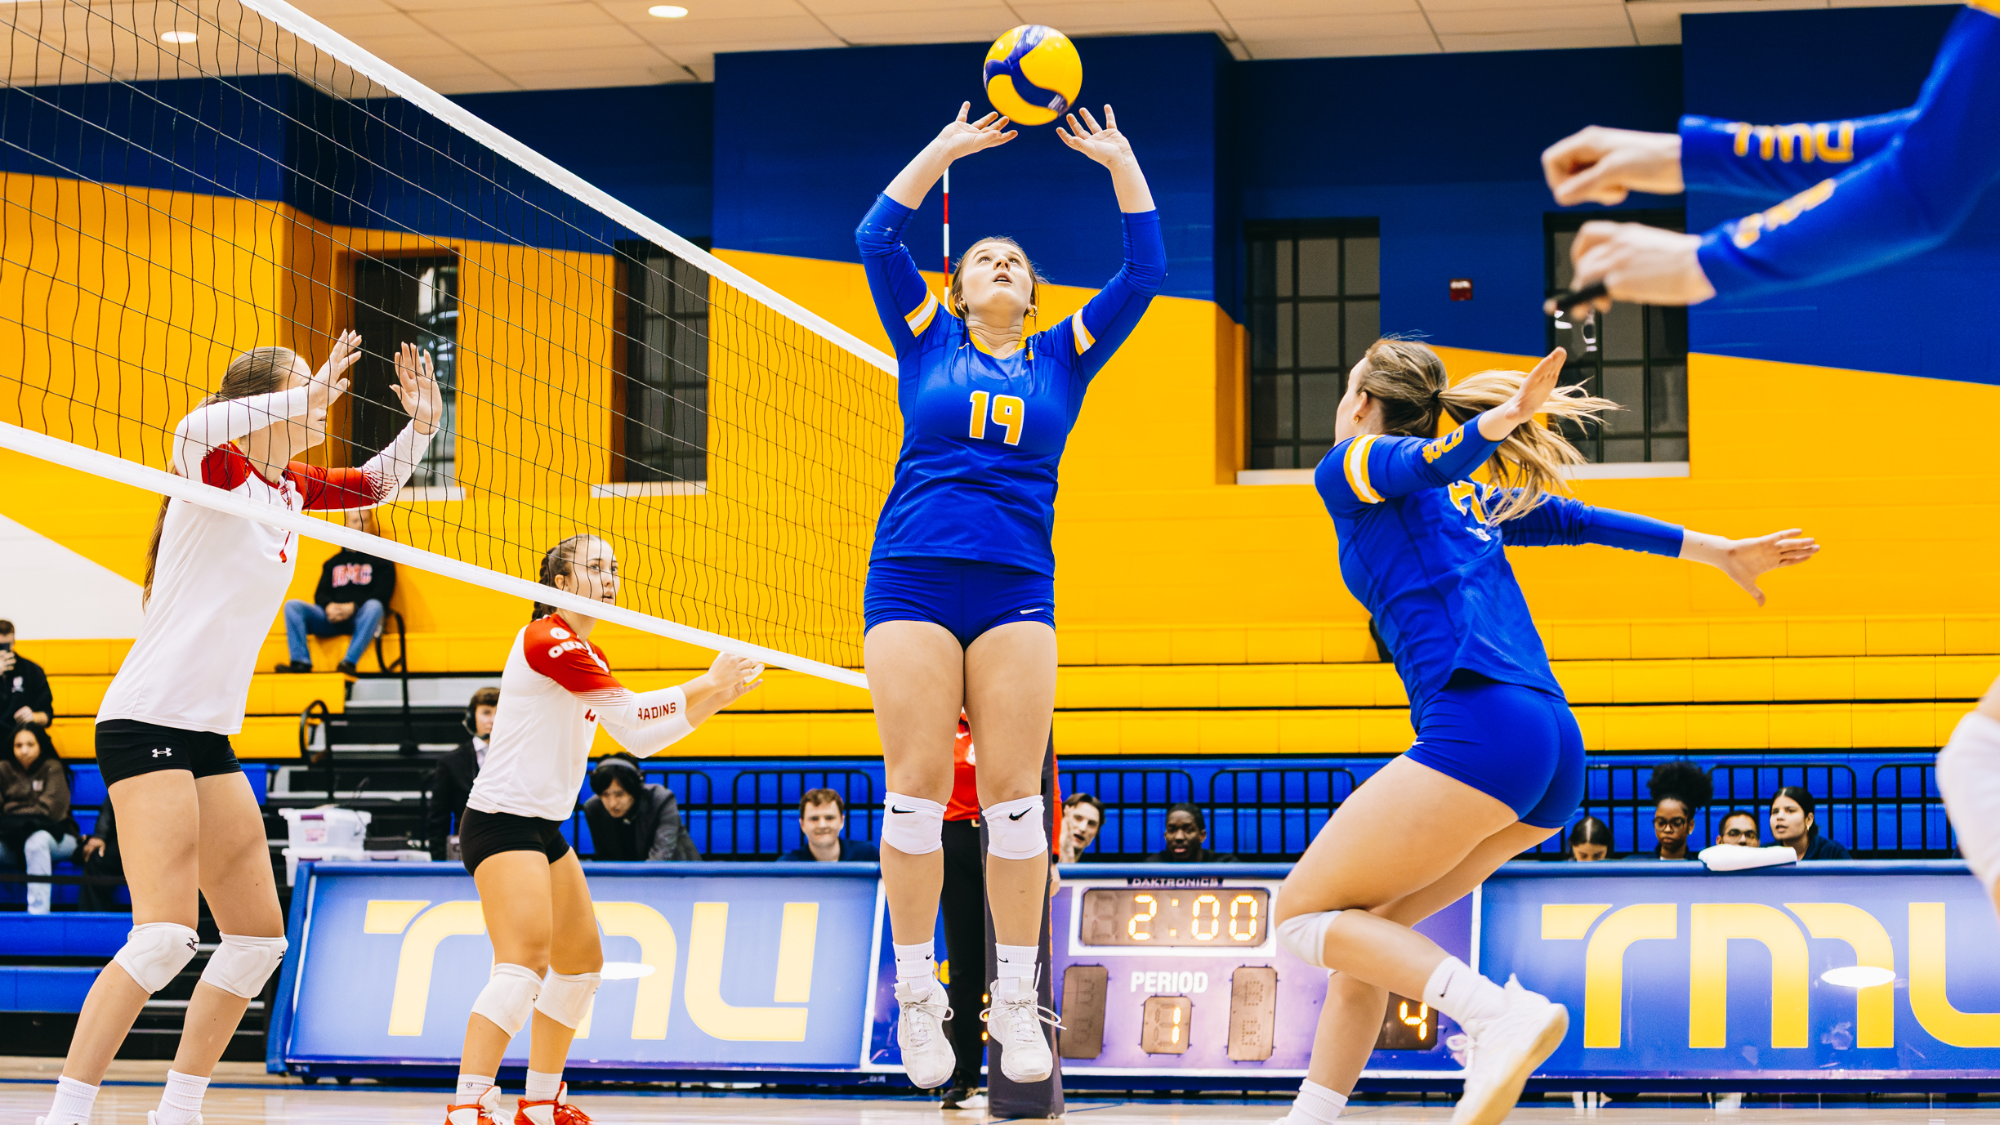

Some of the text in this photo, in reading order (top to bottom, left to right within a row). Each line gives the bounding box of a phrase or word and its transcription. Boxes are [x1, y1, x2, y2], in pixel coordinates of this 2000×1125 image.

[1727, 121, 1855, 163] TMU
[969, 389, 1025, 447] 19
[1131, 877, 1219, 888] DAKTRONICS
[1127, 893, 1259, 942] 2:00
[1129, 971, 1209, 994] PERIOD
[1170, 1005, 1182, 1045] 1
[1399, 1001, 1429, 1041] 4
